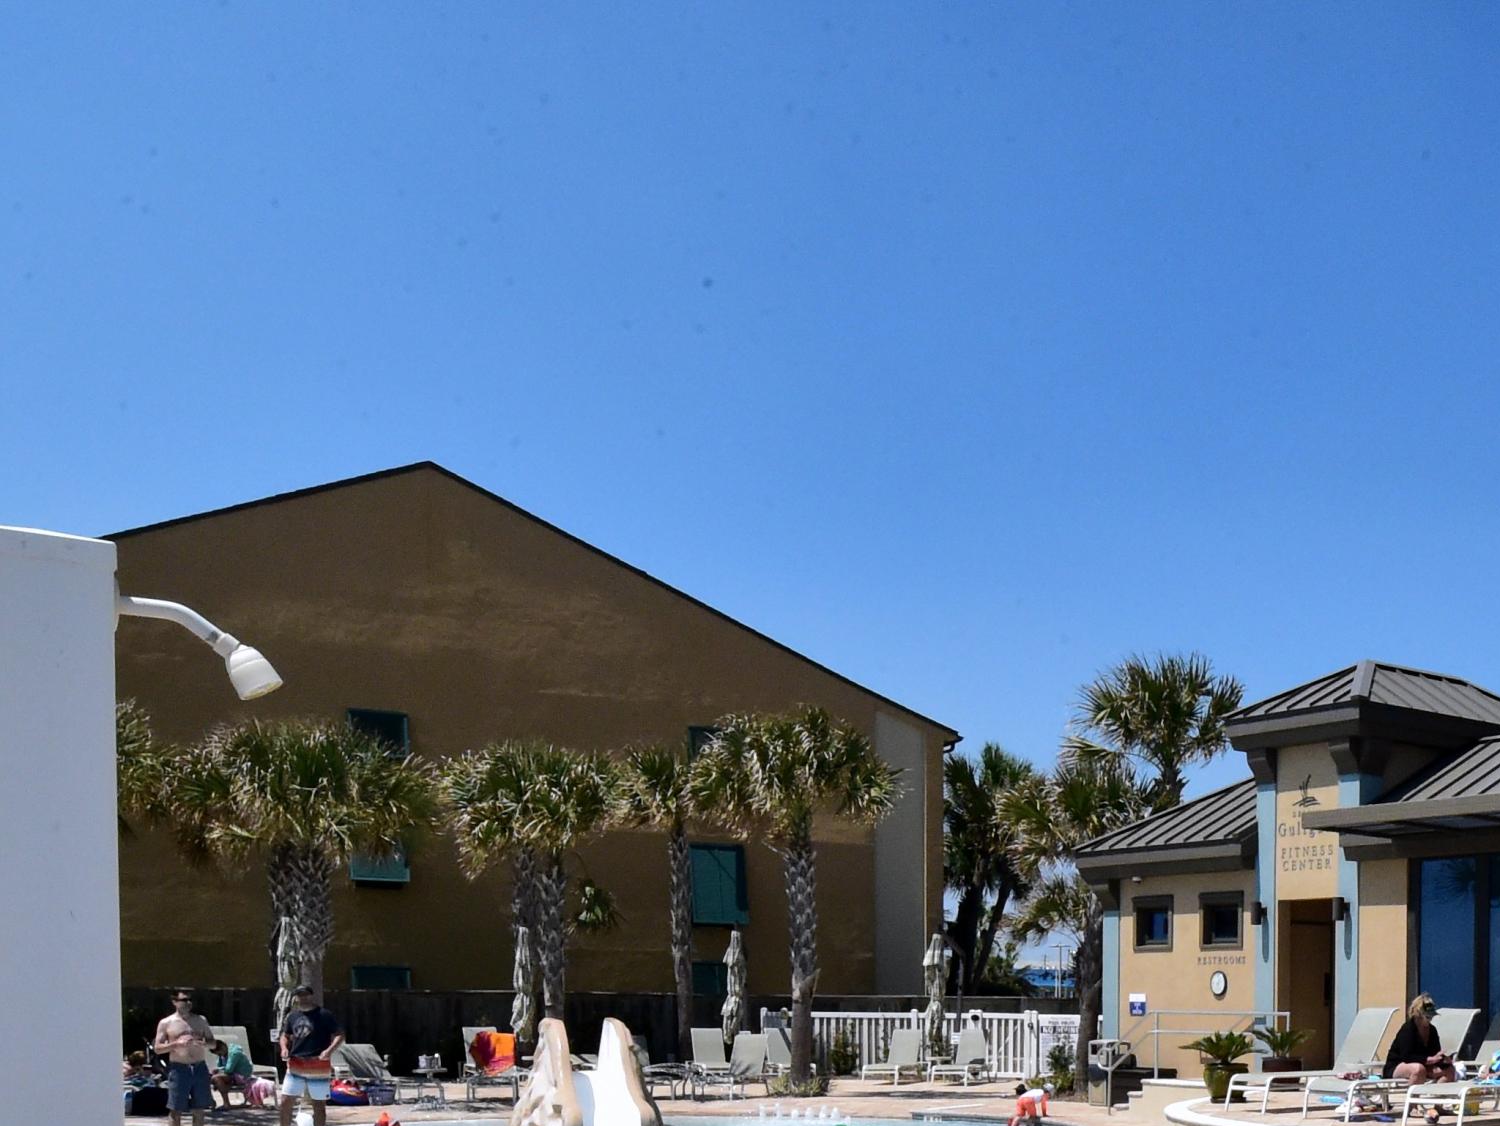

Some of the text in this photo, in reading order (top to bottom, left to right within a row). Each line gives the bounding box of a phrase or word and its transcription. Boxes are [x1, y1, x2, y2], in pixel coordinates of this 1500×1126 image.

[1282, 845, 1334, 859] FITNESS
[1282, 860, 1332, 872] CENTER
[1198, 956, 1246, 965] RESTROOMS
